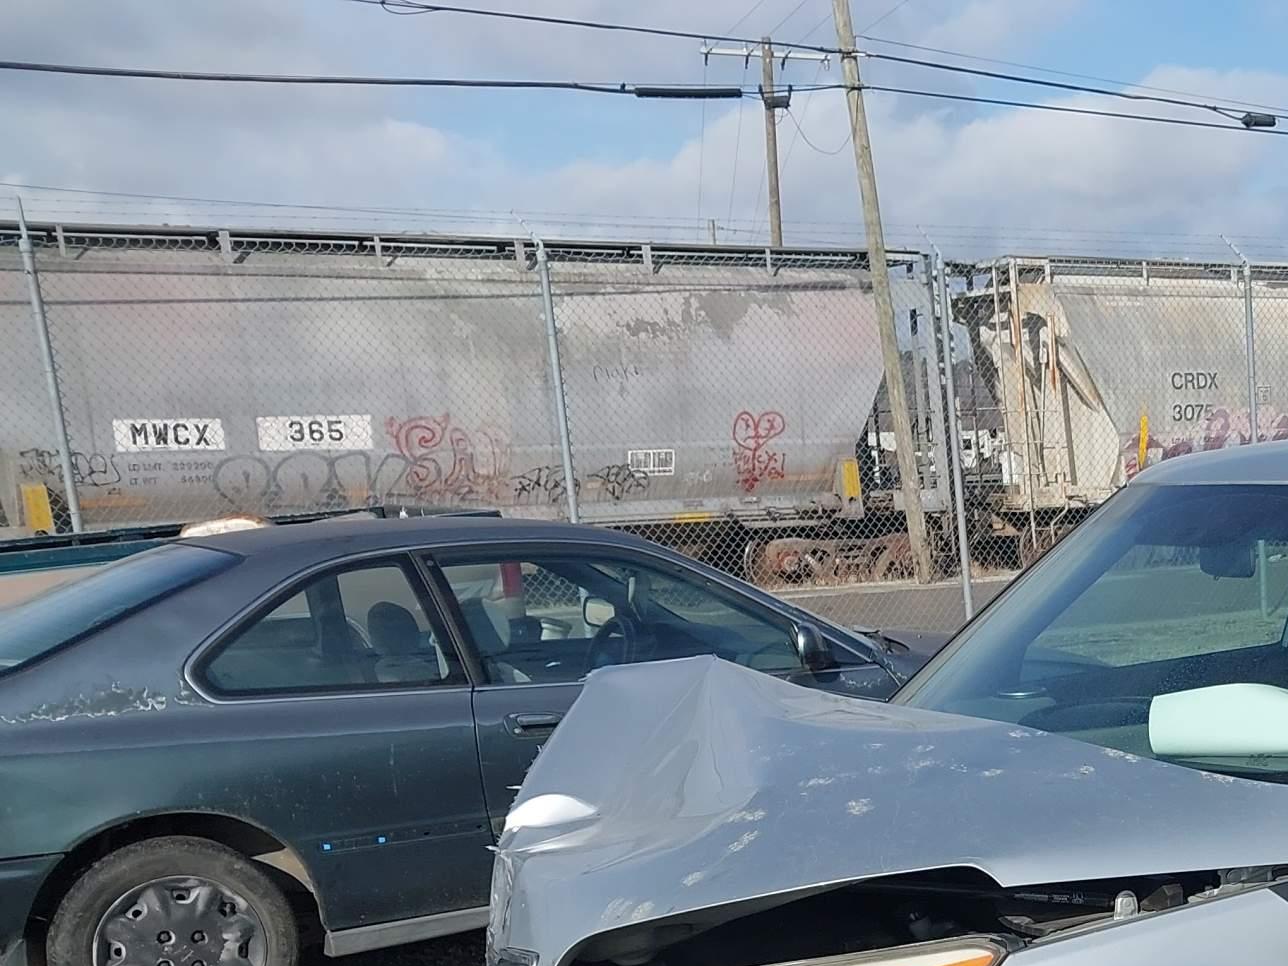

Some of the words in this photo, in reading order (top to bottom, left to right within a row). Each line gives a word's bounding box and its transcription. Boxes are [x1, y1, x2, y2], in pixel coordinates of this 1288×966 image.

[1171, 372, 1219, 390] CRDX
[129, 422, 210, 446] MWCX
[288, 420, 344, 442] 365
